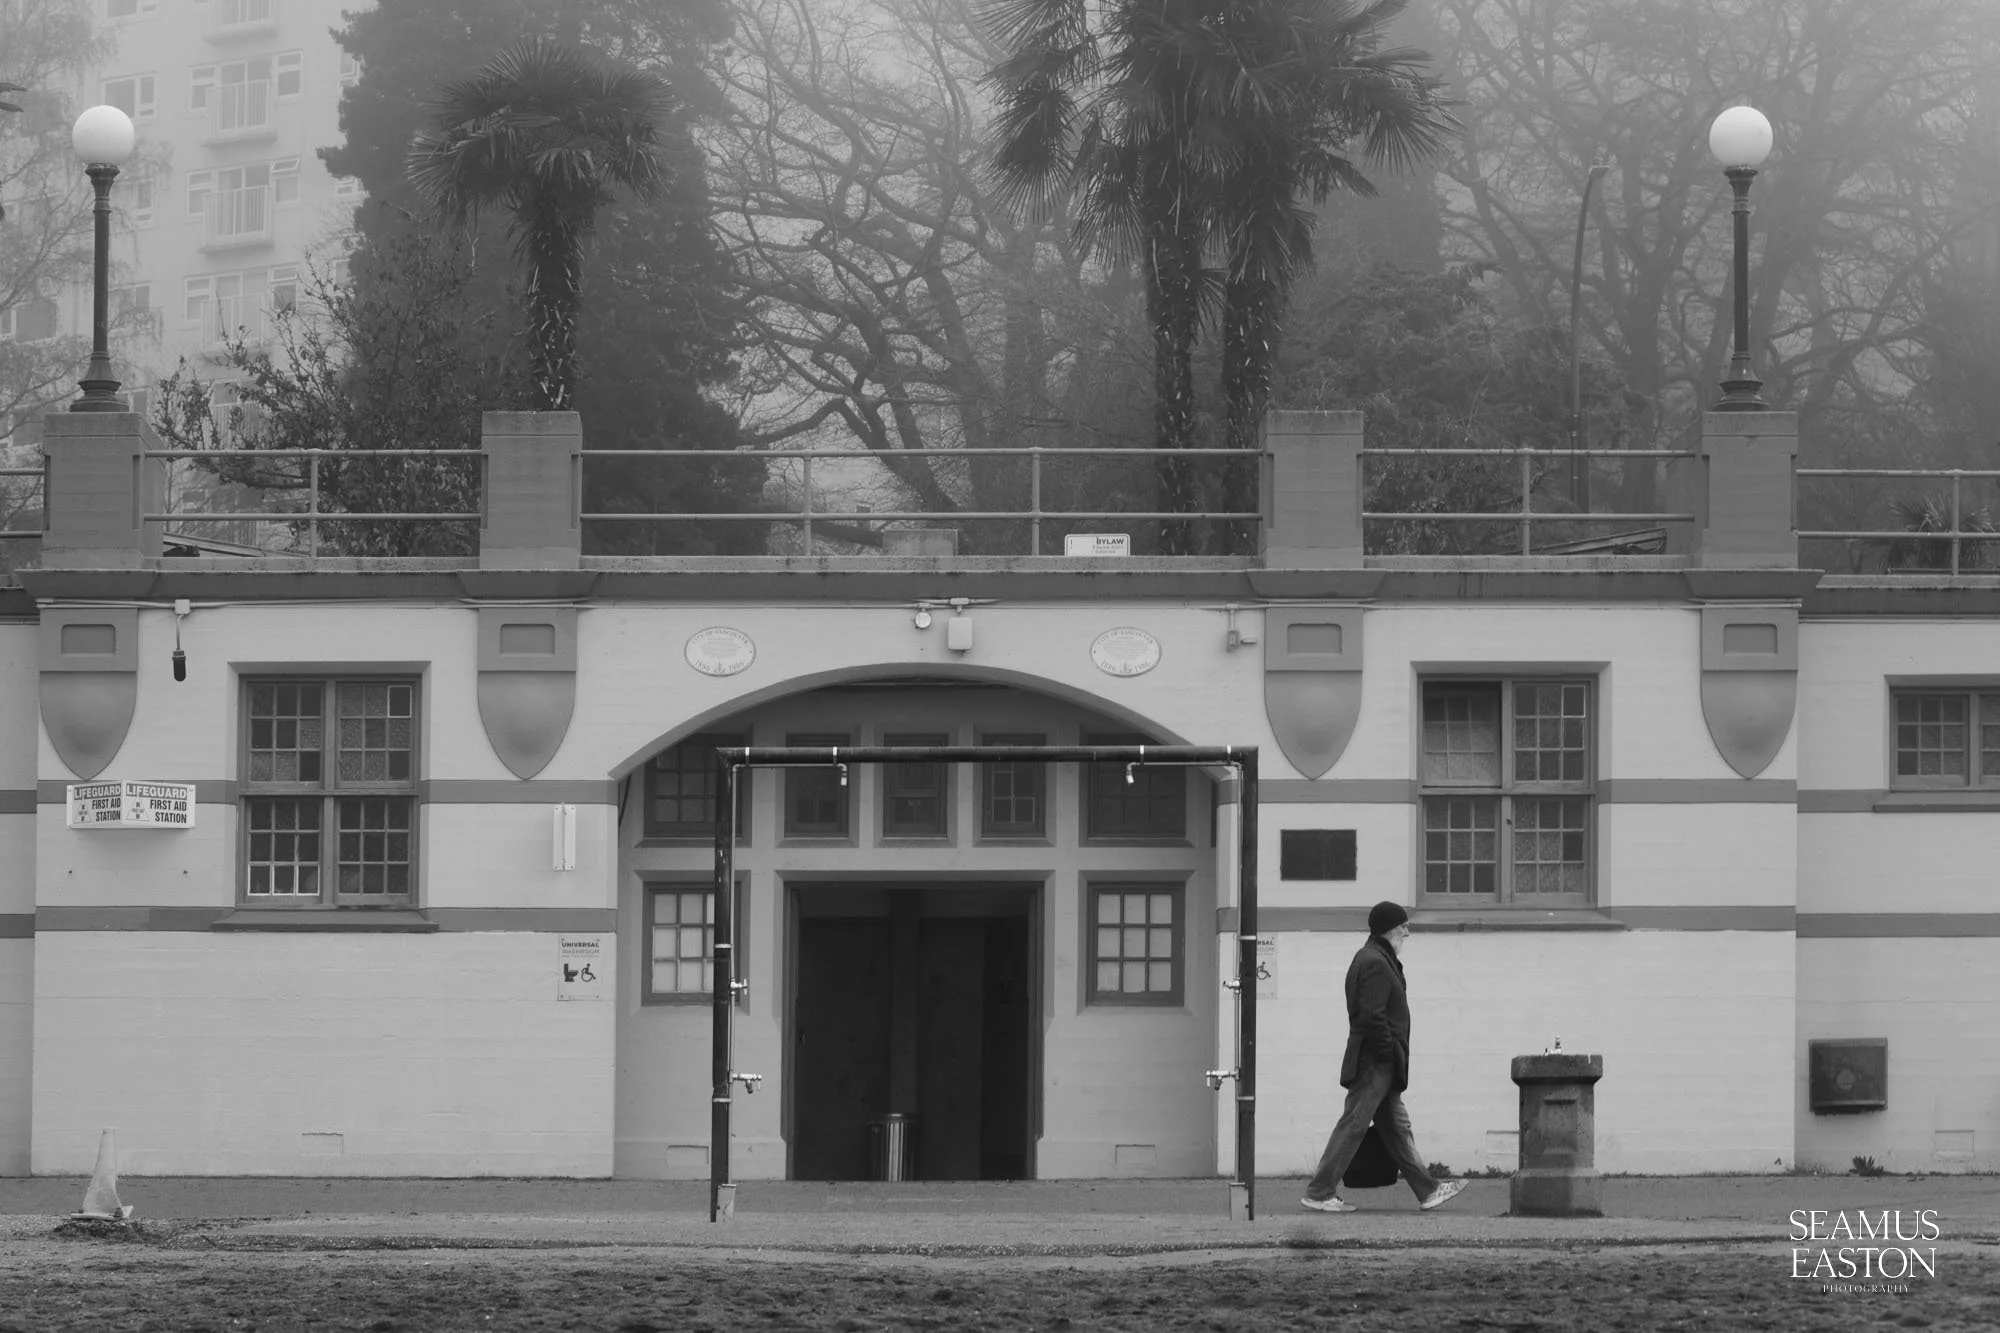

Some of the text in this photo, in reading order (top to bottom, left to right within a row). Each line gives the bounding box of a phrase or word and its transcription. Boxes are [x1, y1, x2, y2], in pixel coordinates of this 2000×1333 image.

[74, 784, 121, 799] LIFEGUARD
[126, 784, 187, 799] LIFEGUARD
[92, 798, 121, 810] FIRST AID
[150, 799, 172, 811] FIRST
[174, 800, 187, 812] AID
[96, 810, 121, 822] STATION
[155, 811, 187, 824] STATION
